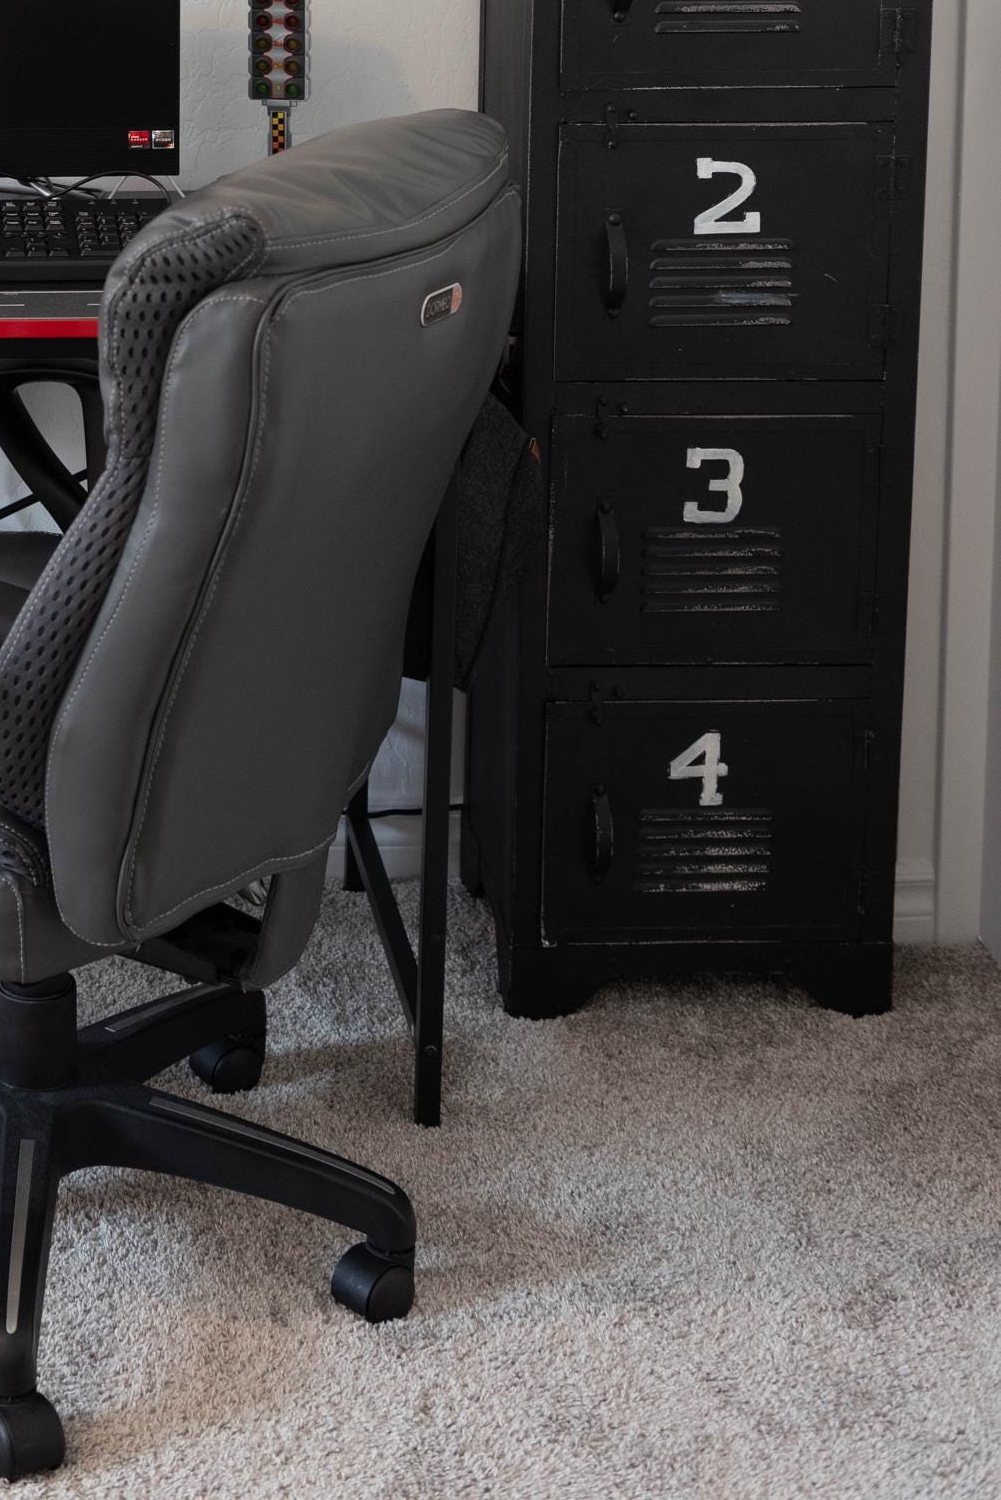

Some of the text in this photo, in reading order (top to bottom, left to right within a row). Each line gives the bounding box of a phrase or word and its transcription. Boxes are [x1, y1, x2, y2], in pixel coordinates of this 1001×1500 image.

[693, 157, 761, 235] 2
[683, 446, 745, 524] 3
[668, 731, 730, 806] 4
